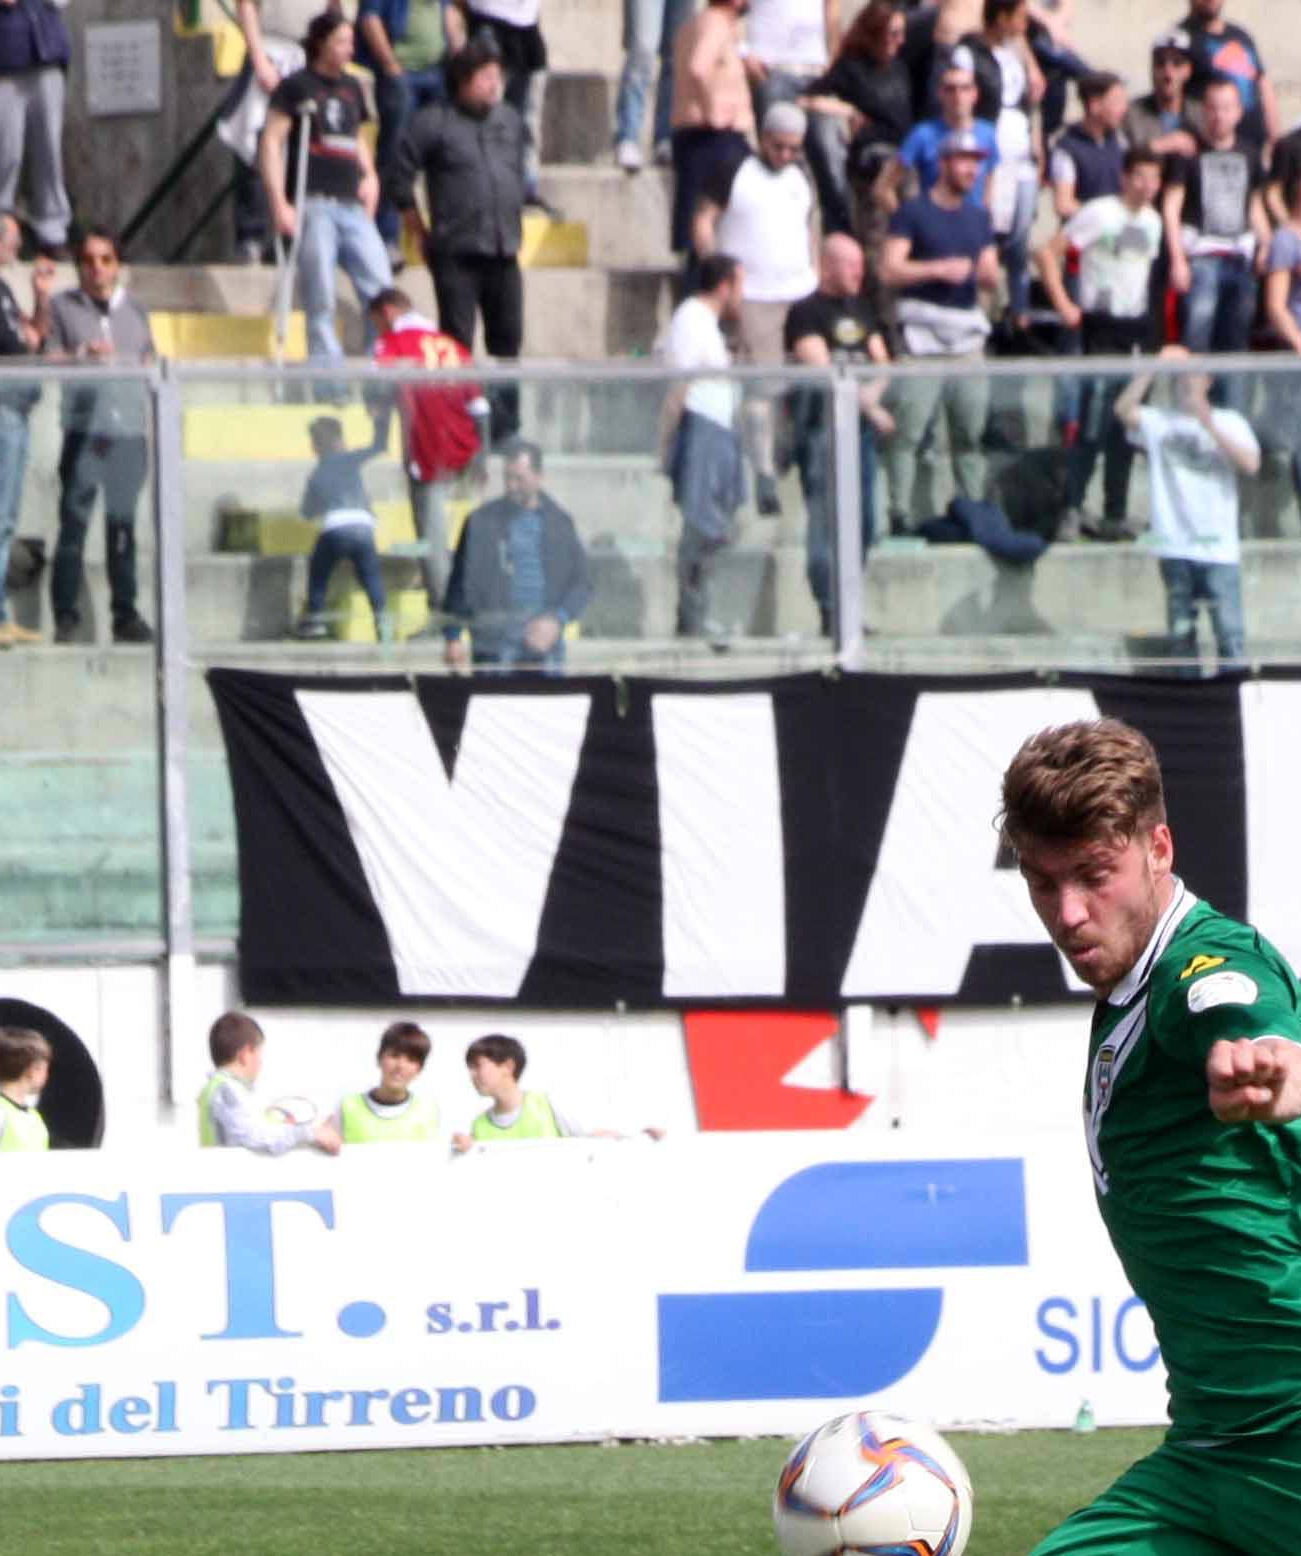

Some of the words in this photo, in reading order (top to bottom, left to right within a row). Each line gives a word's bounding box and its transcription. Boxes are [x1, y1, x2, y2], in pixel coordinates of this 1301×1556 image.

[426, 1288, 562, 1335] s.r.l.
[51, 1380, 180, 1437] del
[207, 1375, 538, 1433] Tirreno
